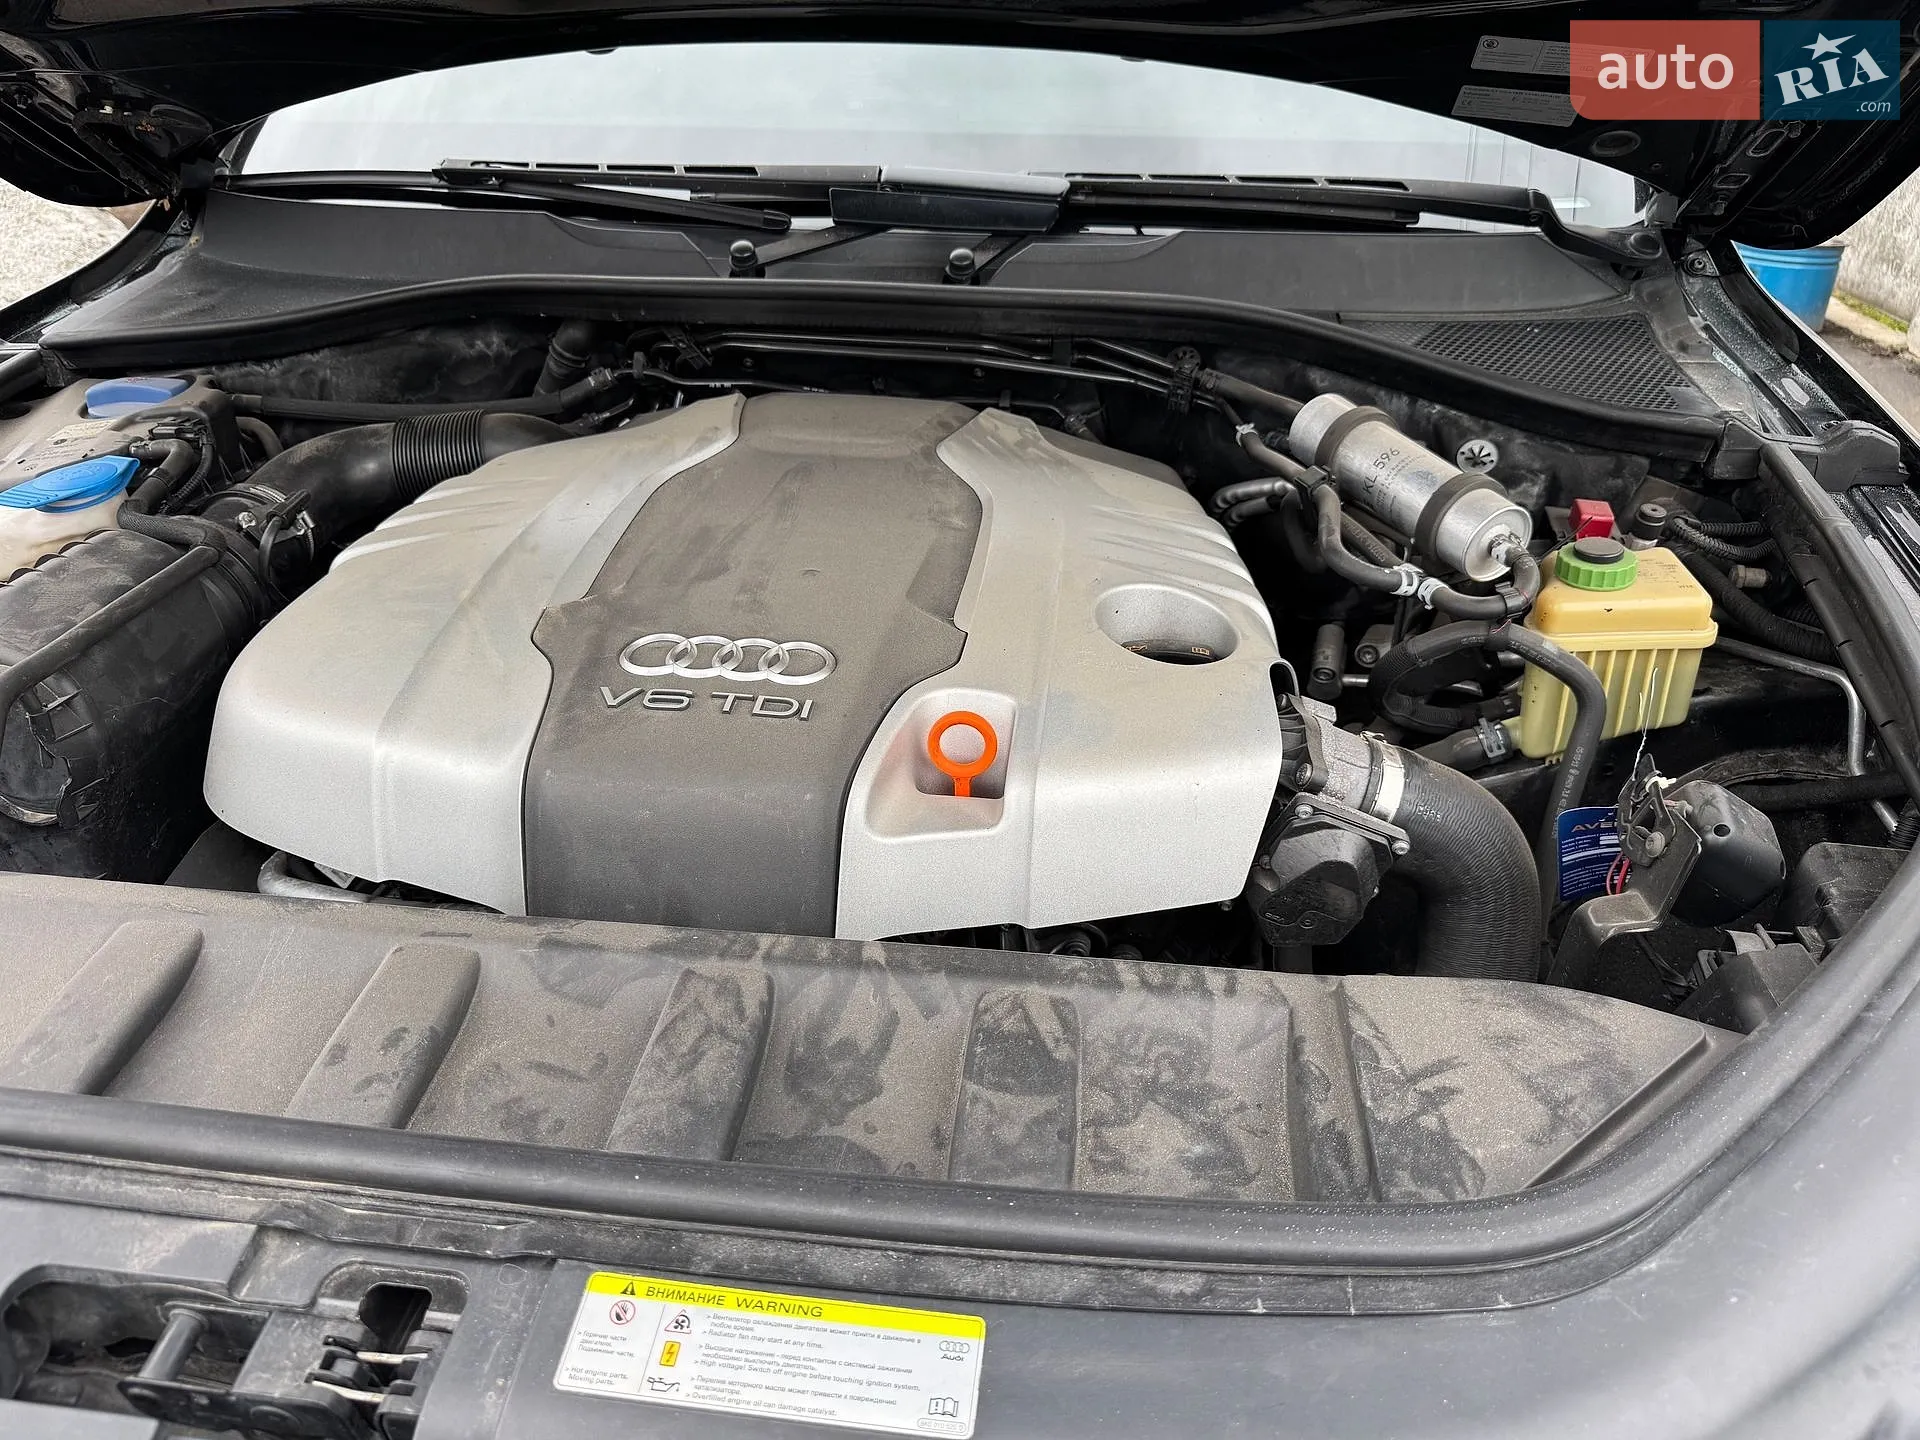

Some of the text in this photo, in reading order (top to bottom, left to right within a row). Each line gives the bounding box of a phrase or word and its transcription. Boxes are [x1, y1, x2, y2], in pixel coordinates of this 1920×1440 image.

[1373, 447, 1400, 470] 596
[600, 686, 815, 721] V6 TDI
[1571, 821, 1618, 833] AVE
[646, 1286, 823, 1317] ВНИМАНИЕ WARNING
[712, 1313, 751, 1324] Вентилятор
[708, 1329, 736, 1338] Radiator
[751, 1335, 766, 1343] may
[792, 1340, 805, 1348] any
[941, 1353, 965, 1361] Audi
[700, 1359, 717, 1368] High
[747, 1364, 771, 1373] Switch
[783, 1370, 807, 1379] engine
[808, 1372, 832, 1381] before
[832, 1375, 864, 1386] touching
[865, 1379, 892, 1389] ignition
[691, 1392, 726, 1402] Overfilled
[727, 1397, 751, 1406] engine
[752, 1399, 762, 1407] oil
[777, 1403, 806, 1413] damage
